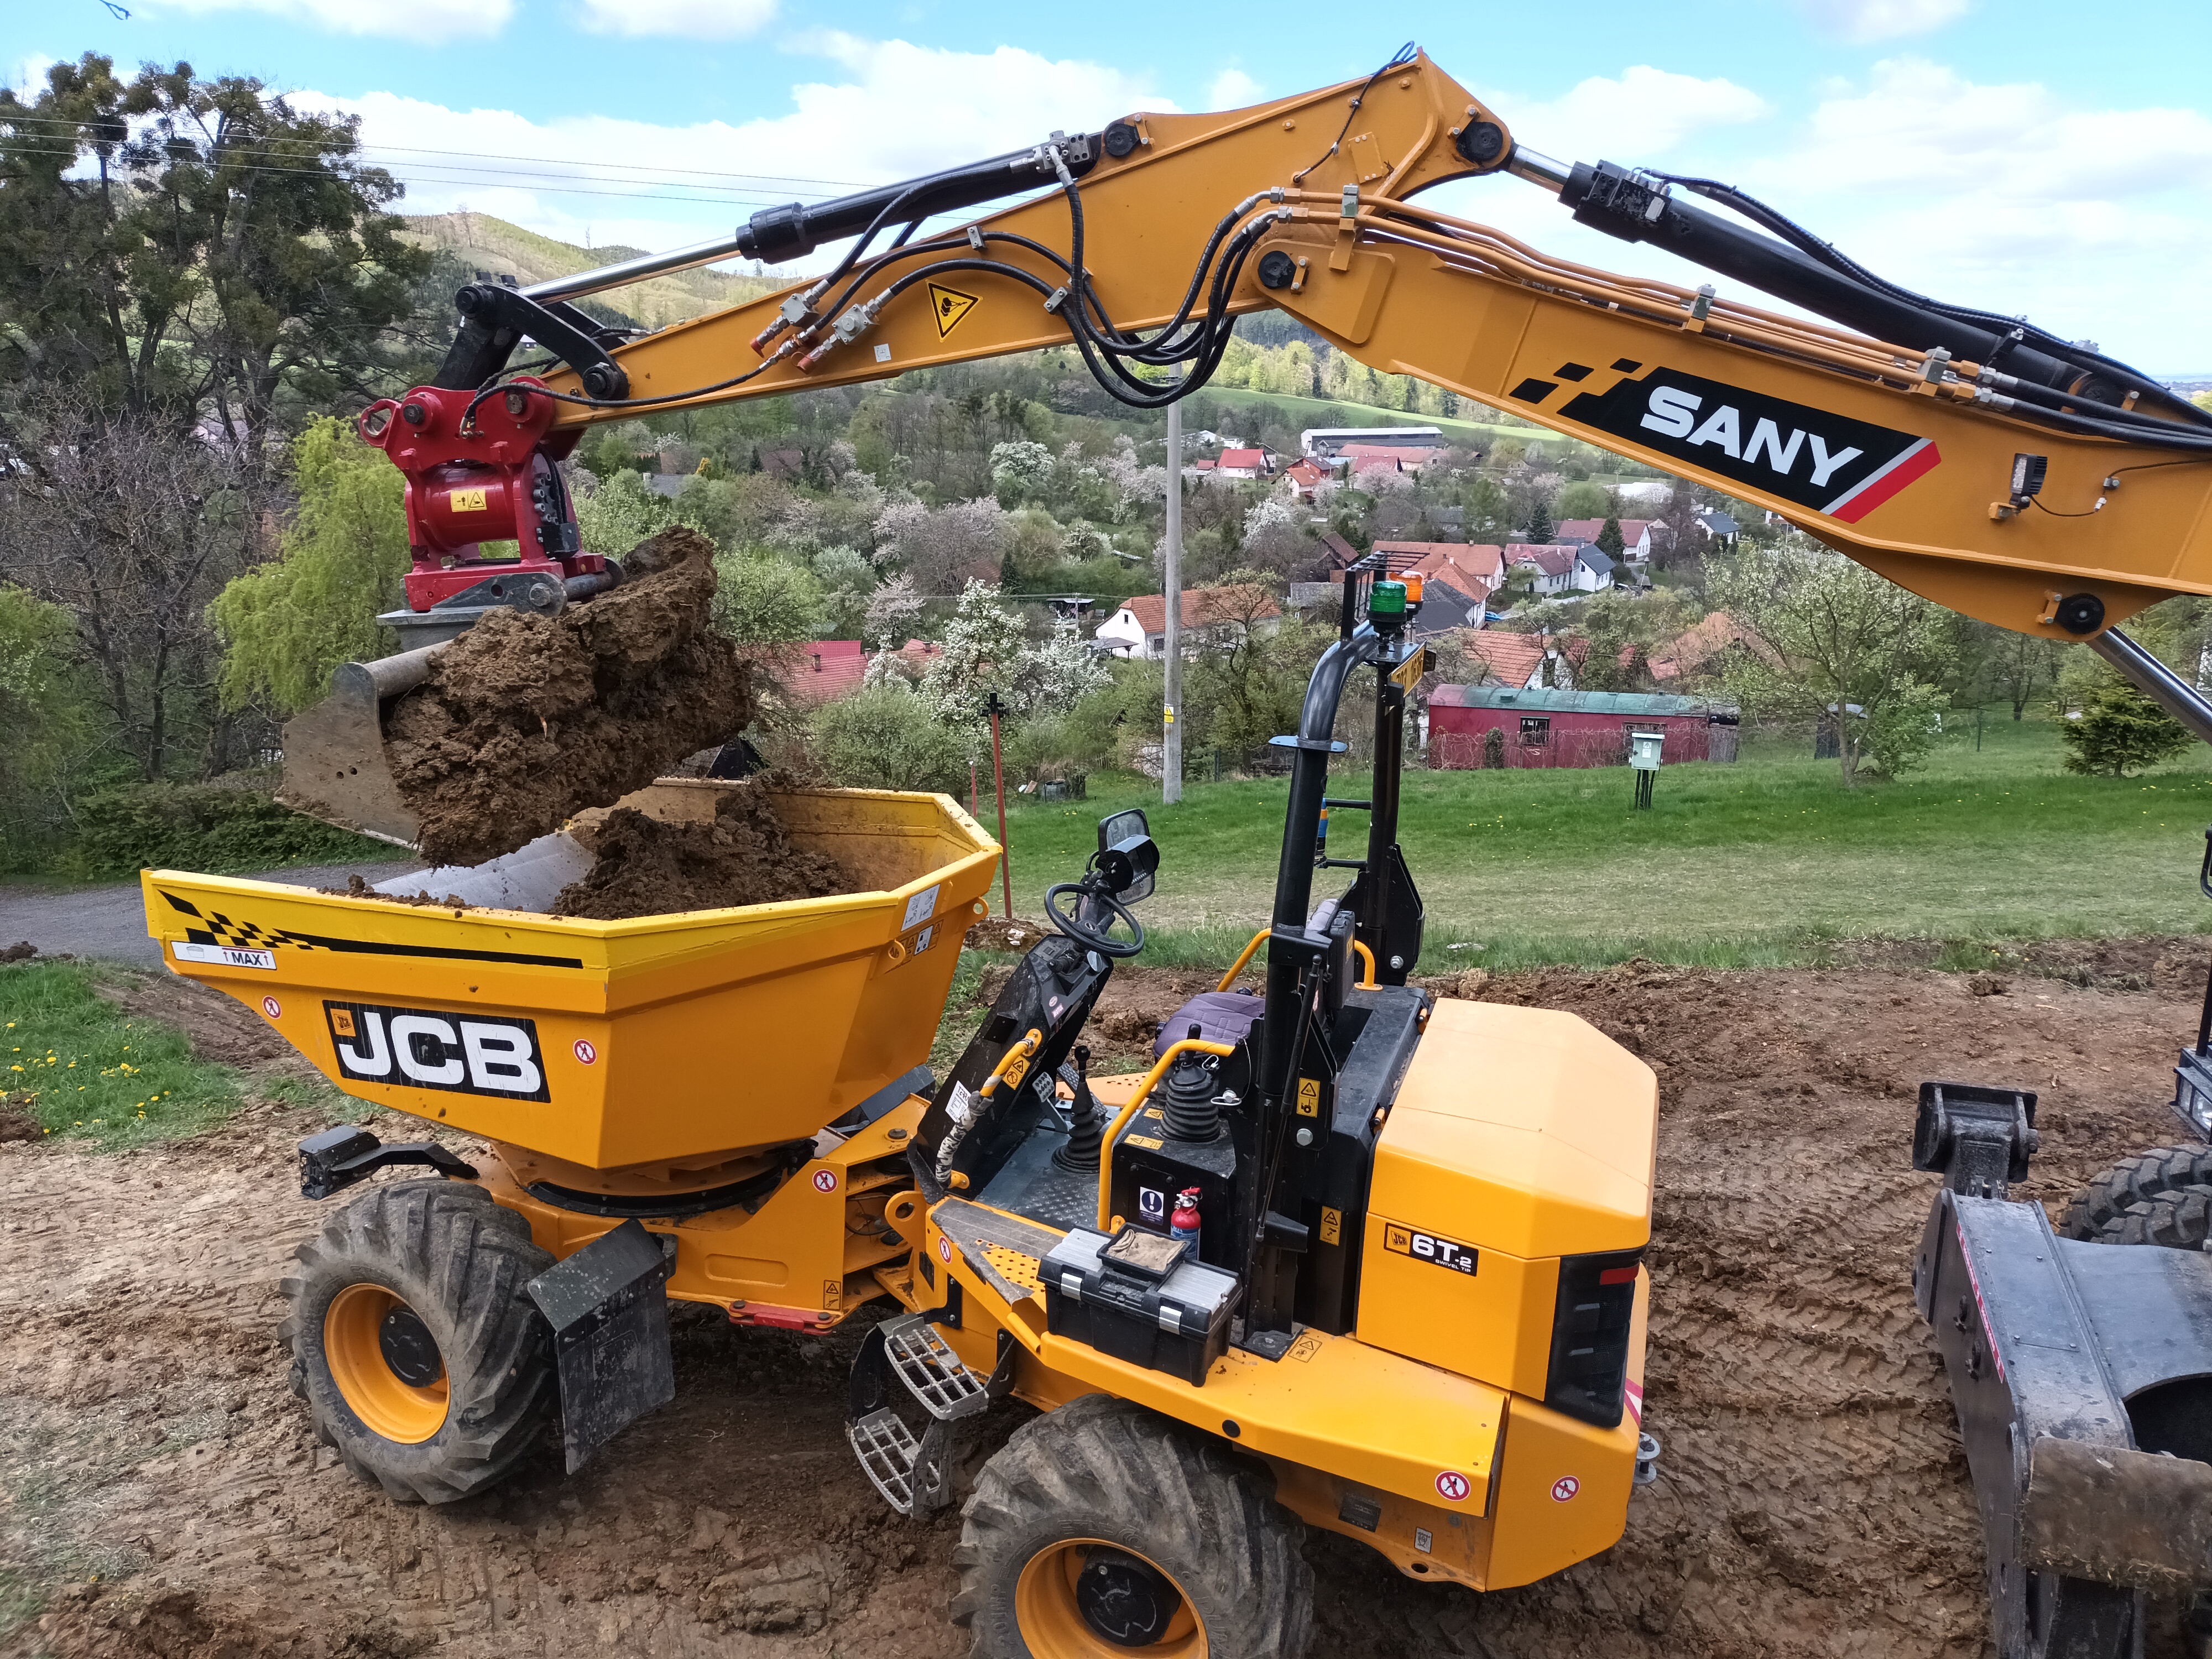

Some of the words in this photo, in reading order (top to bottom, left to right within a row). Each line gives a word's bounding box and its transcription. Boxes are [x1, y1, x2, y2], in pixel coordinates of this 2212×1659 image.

[1640, 386, 1864, 487] SANY
[231, 952, 263, 966] MAX
[336, 1015, 352, 1030] JCB
[338, 1011, 541, 1093] JCB
[1393, 1233, 1407, 1245] JCB
[1435, 1259, 1459, 1270] SWIVEL
